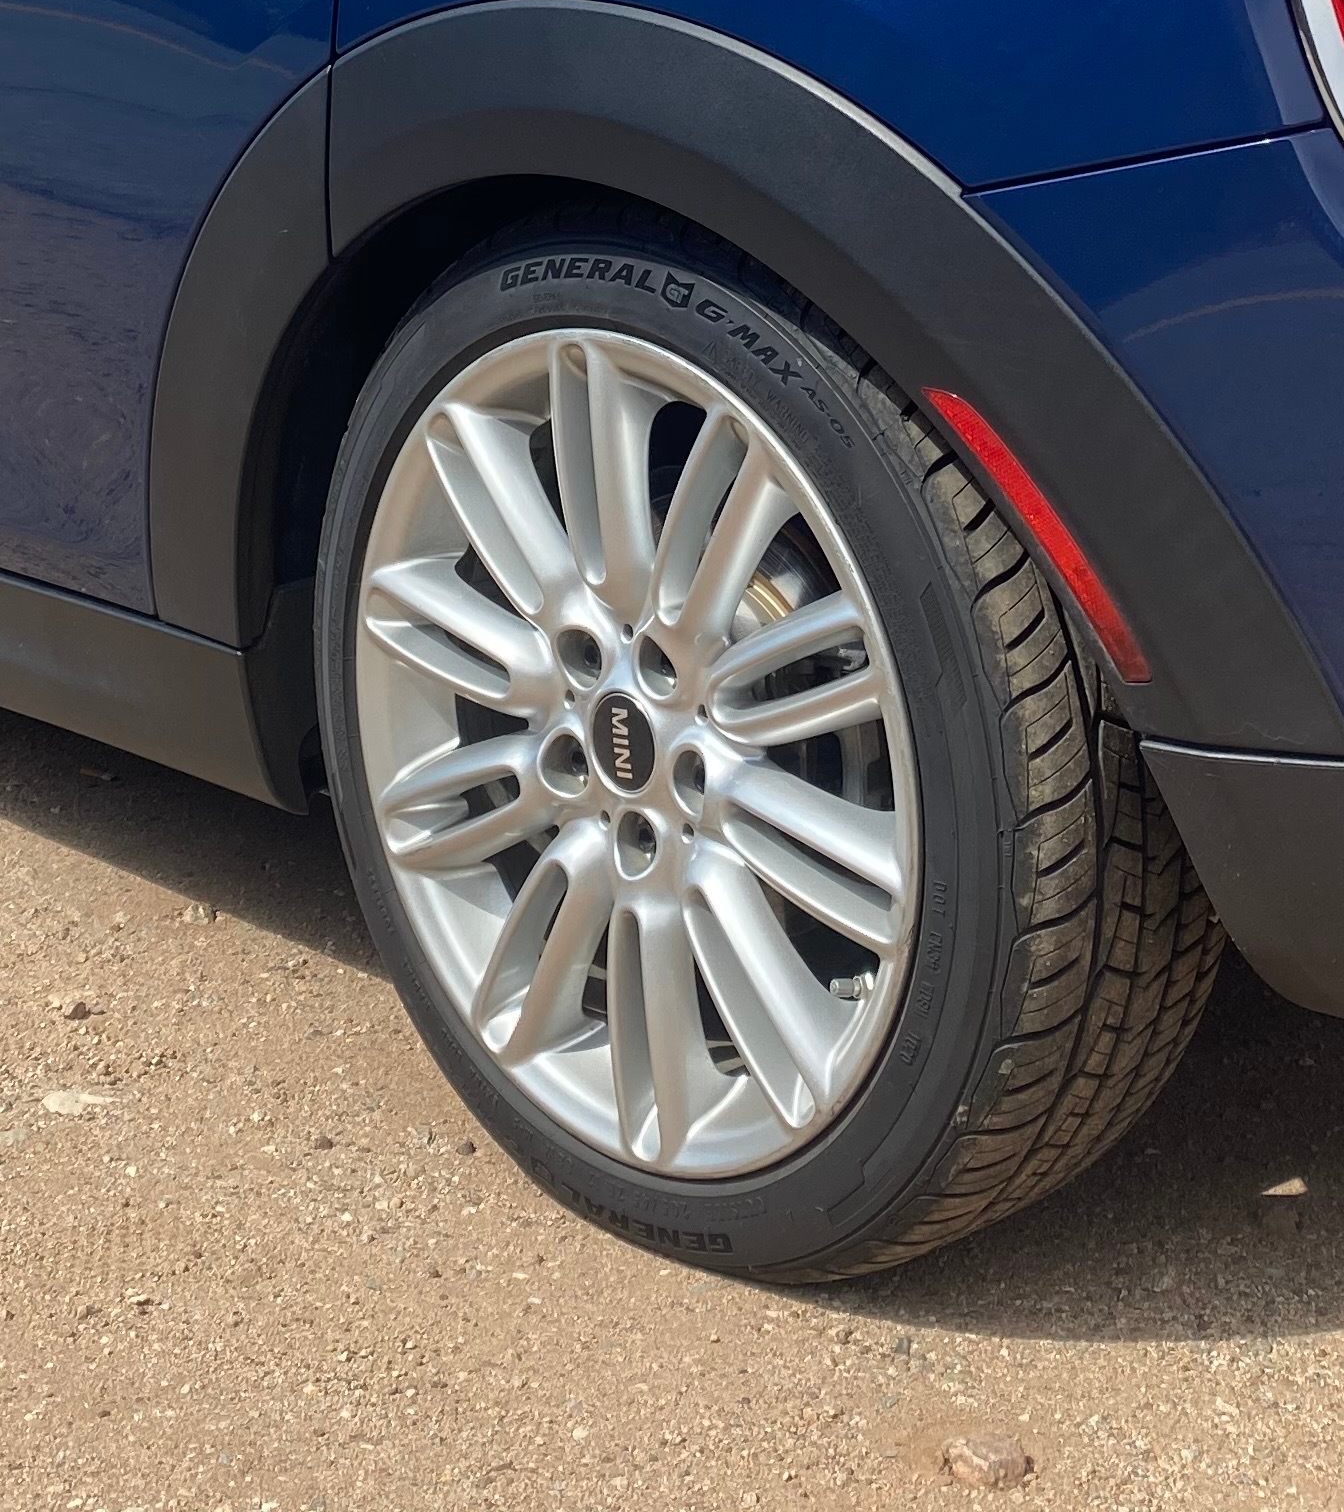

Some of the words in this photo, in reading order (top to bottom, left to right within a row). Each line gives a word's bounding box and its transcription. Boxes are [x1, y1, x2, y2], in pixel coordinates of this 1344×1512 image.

[499, 257, 656, 294] GENERAL
[799, 386, 856, 449] AS-05
[611, 706, 634, 780] MINI
[561, 1184, 734, 1256] GENERAL
